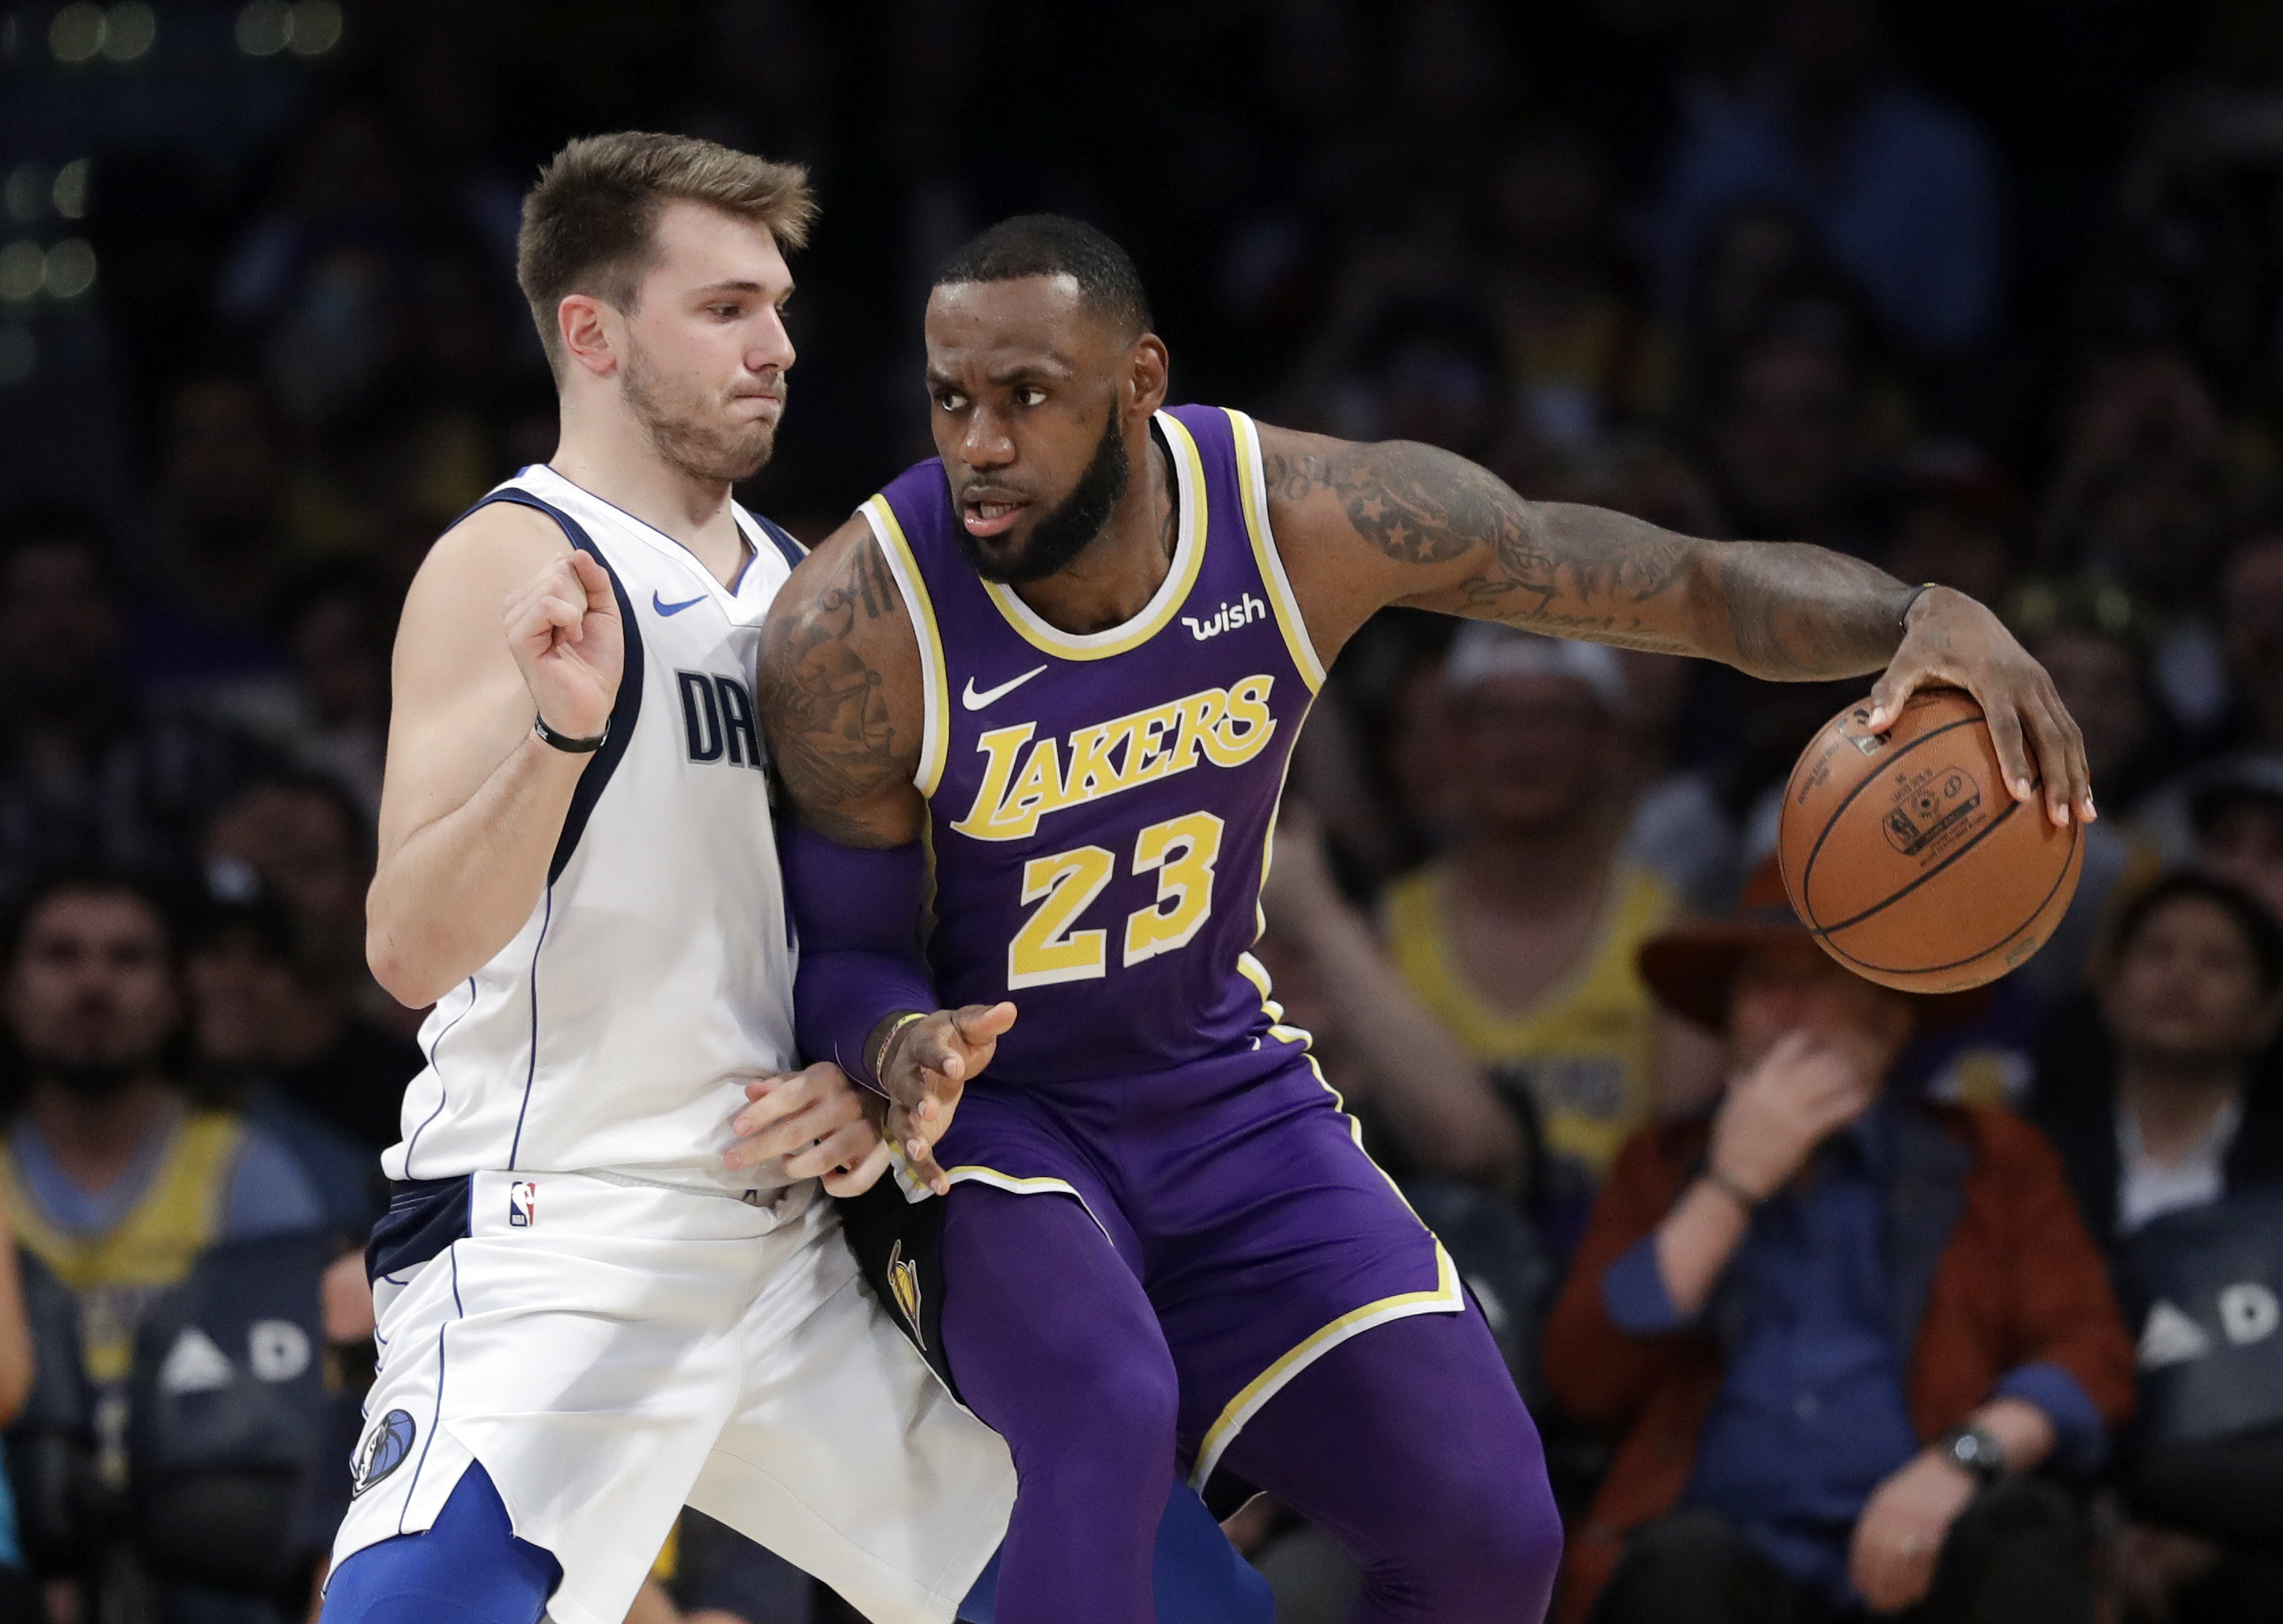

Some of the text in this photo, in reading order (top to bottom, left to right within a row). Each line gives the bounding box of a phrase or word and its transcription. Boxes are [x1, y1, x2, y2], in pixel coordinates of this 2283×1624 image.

[1181, 592, 1266, 641] wish
[950, 674, 1278, 841] LAKERS
[1007, 811, 1225, 990] 23
